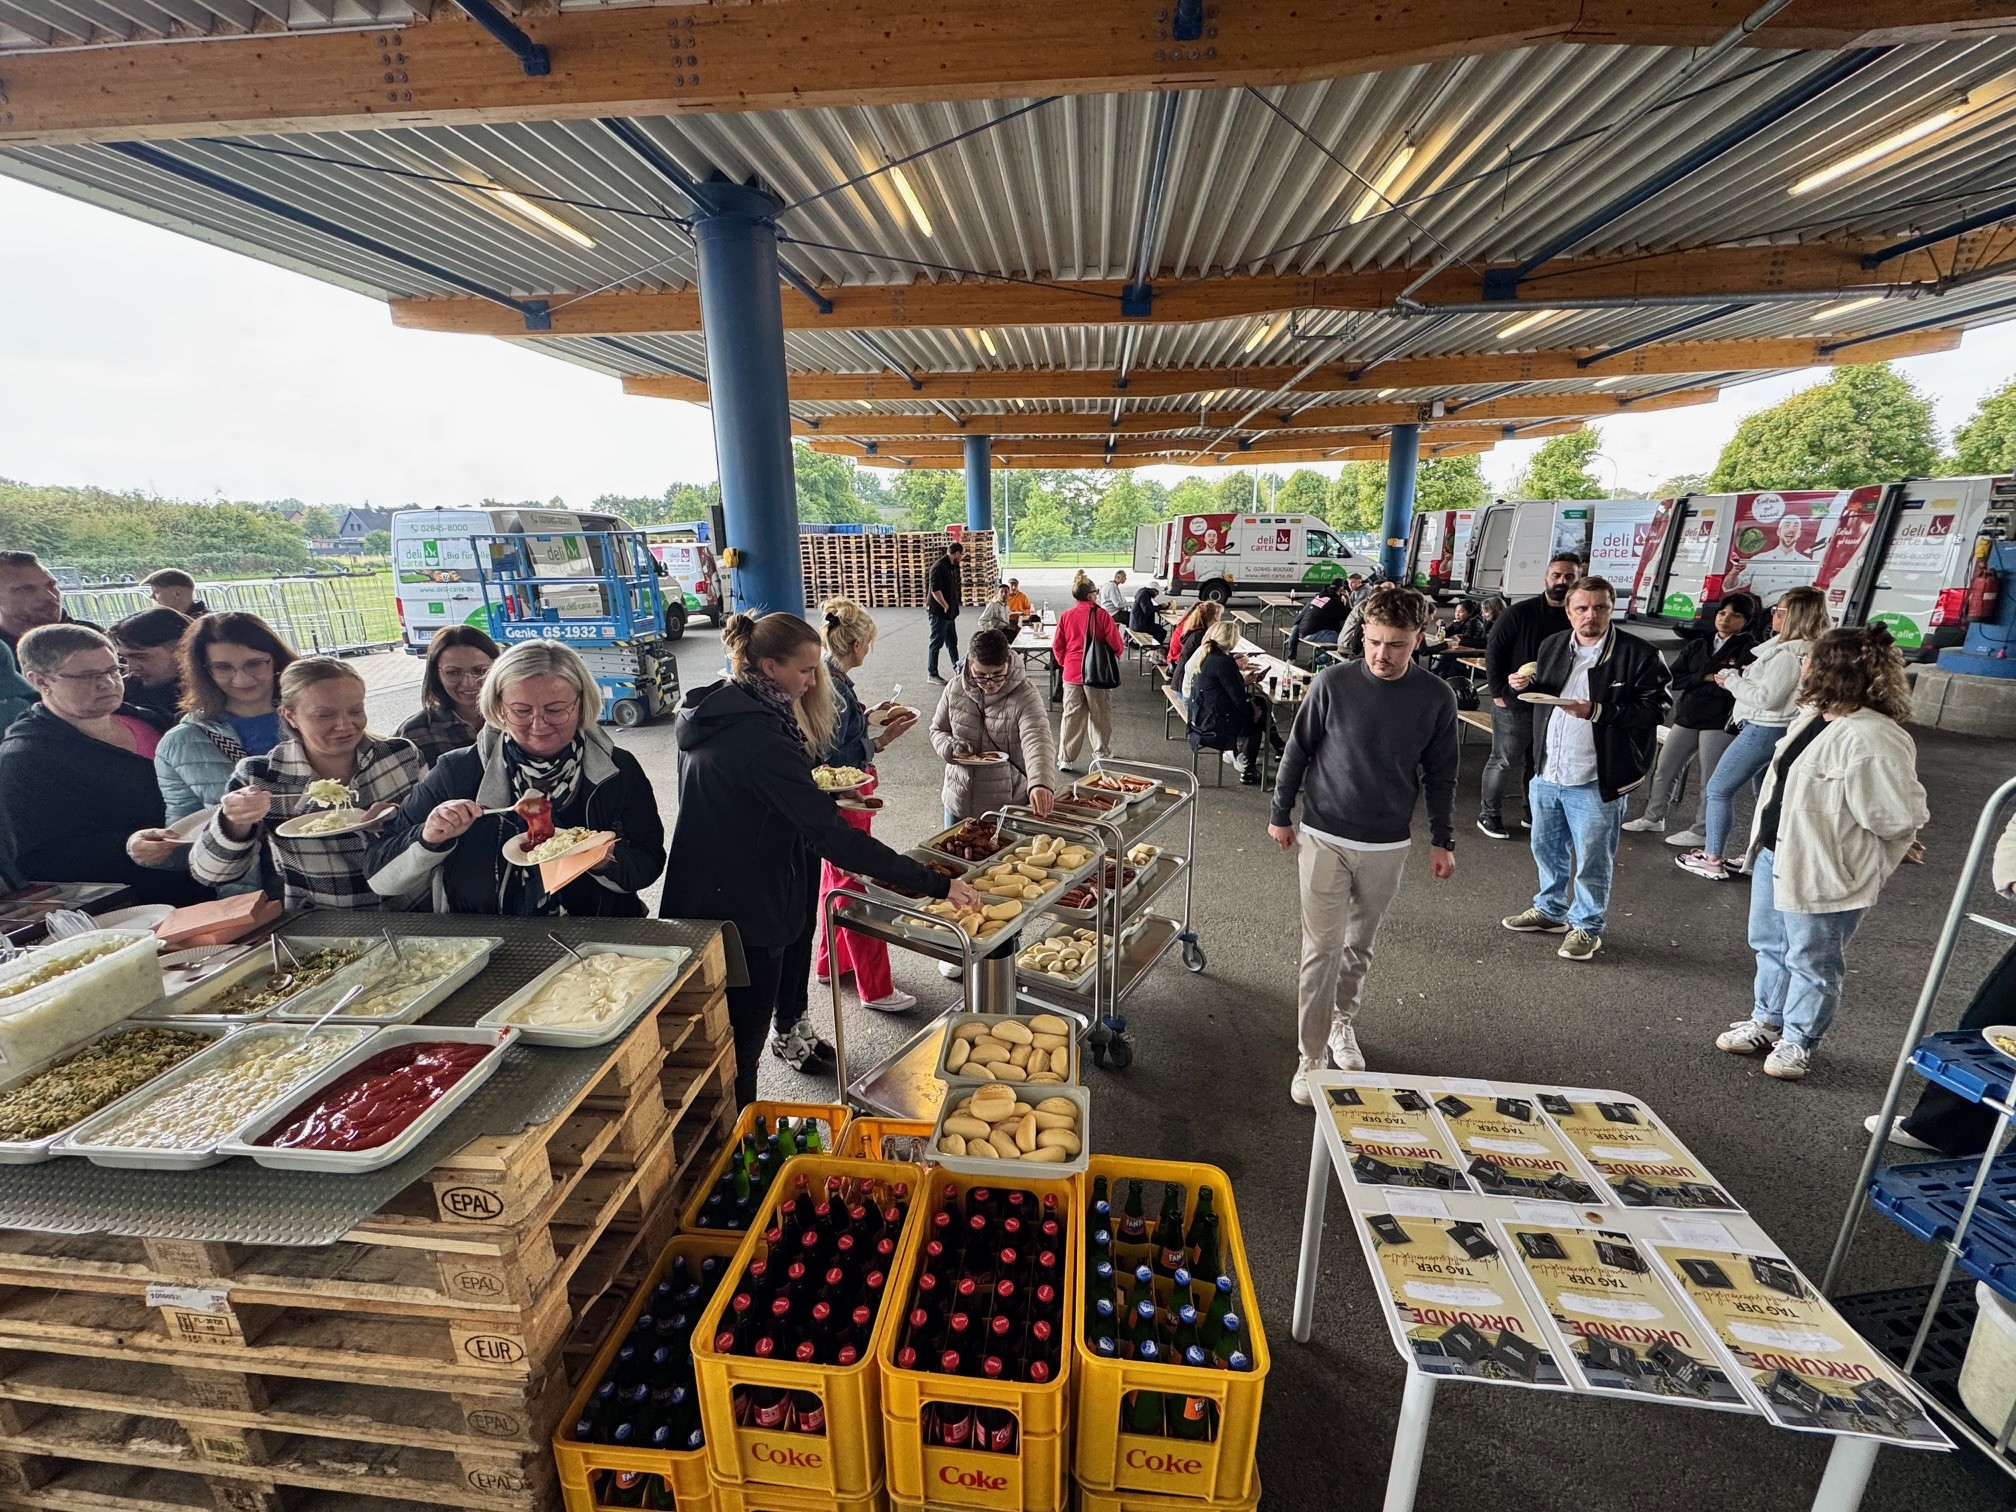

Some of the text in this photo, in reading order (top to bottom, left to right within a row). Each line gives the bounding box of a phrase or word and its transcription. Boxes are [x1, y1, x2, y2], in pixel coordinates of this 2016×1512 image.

[420, 524, 468, 532] 02845-8000
[1684, 528, 1698, 536] deli
[1902, 525, 1926, 536] deli
[1257, 535, 1274, 544] deli
[1603, 533, 1630, 547] deli
[1889, 537, 1921, 546] carte
[406, 549, 422, 559] deli
[547, 544, 566, 561] deli
[1250, 543, 1274, 552] carte
[1592, 547, 1629, 558] carte
[419, 585, 475, 593] www.deli-carte.de
[505, 625, 598, 638] Genie GS-1932
[1500, 1127, 1524, 1135] TAG
[1354, 1144, 1442, 1160] URKUNDE
[1472, 1154, 1568, 1172] URKUNDE
[1602, 1163, 1696, 1178] URKUNDE
[450, 1193, 495, 1214] EPAL
[1416, 1263, 1473, 1276] TAG DER
[461, 1276, 499, 1292] EPAL
[1566, 1274, 1627, 1288] TAG DER
[1732, 1302, 1798, 1318] TAG DER
[1409, 1307, 1525, 1333] URKUNDE
[1568, 1320, 1692, 1348] URKUNDE
[476, 1339, 512, 1361] EUR
[1744, 1352, 1875, 1381] URKUNDE
[473, 1414, 514, 1432] EPAL
[751, 1442, 823, 1469] Coke
[1126, 1448, 1203, 1475] Coke
[938, 1465, 1008, 1491] Coke
